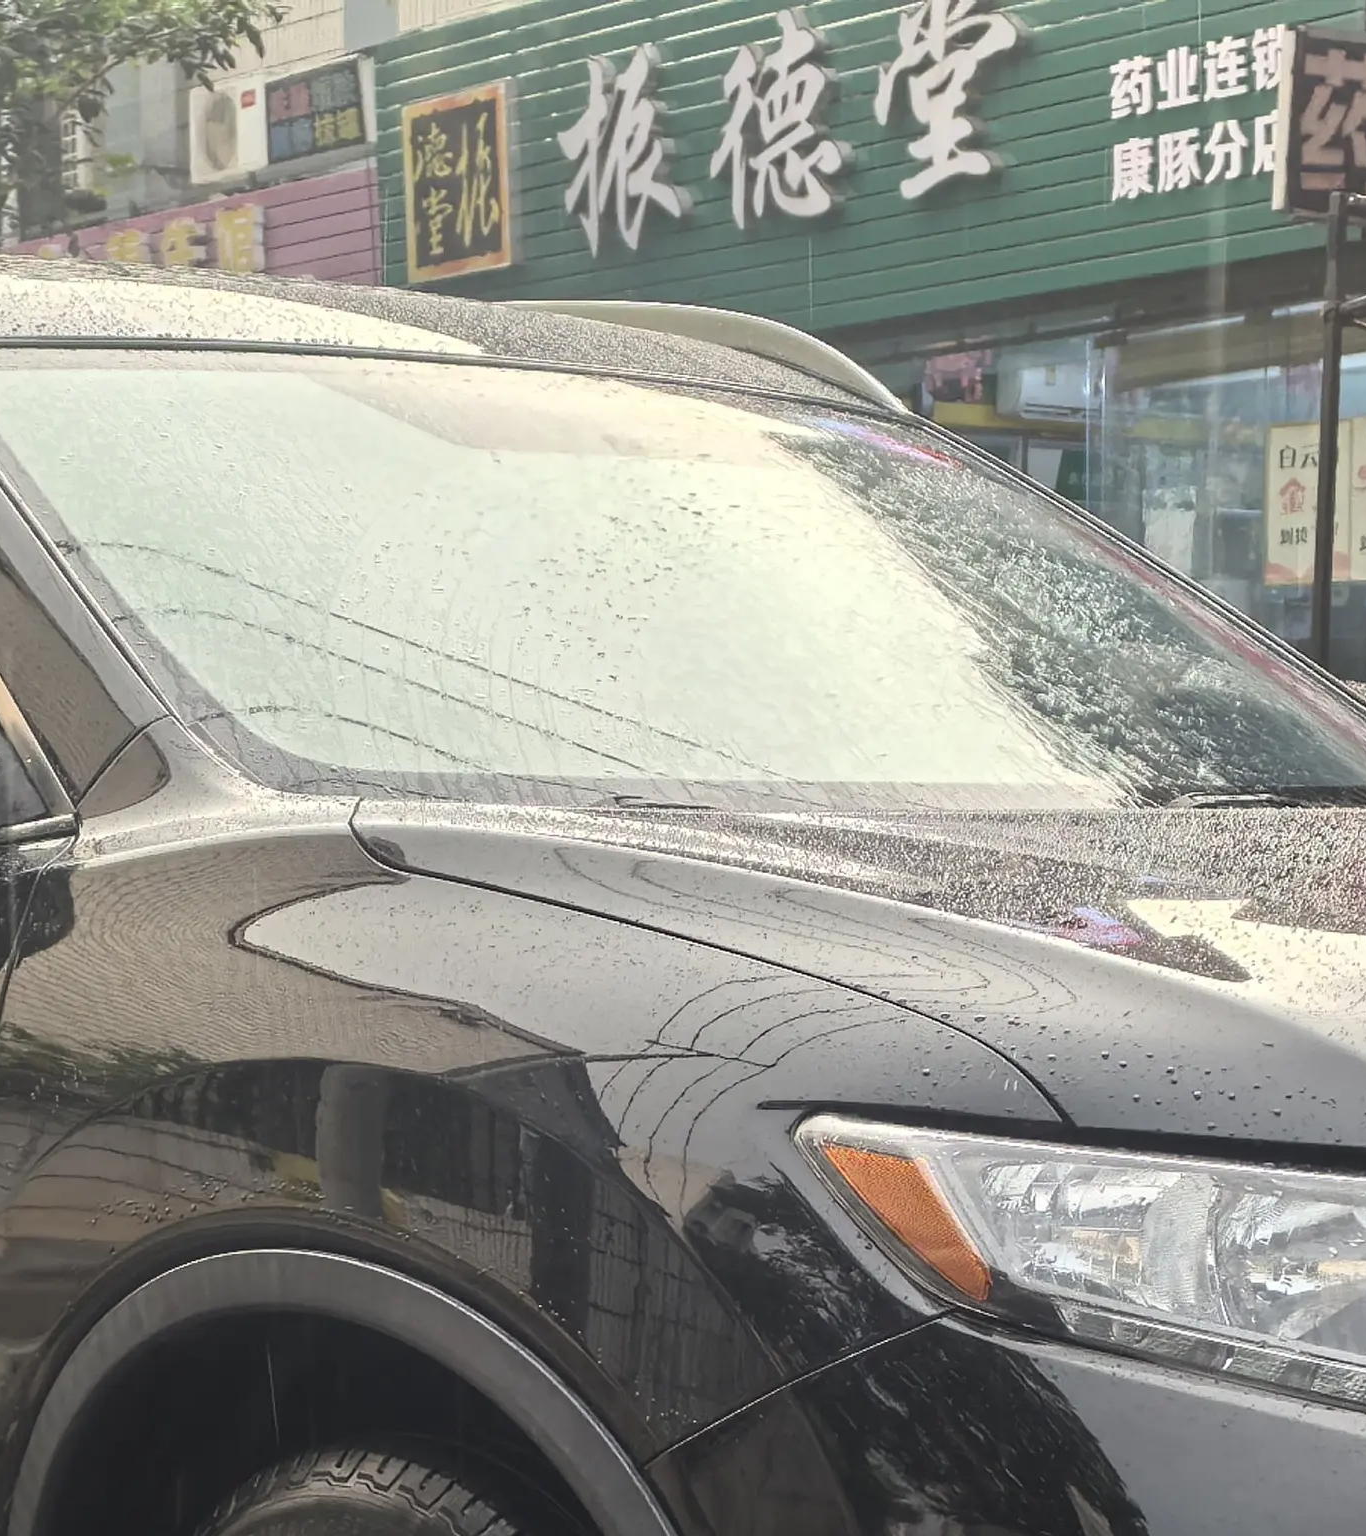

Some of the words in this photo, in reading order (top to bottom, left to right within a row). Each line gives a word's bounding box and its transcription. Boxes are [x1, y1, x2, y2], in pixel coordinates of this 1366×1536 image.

[557, 0, 1021, 258] 振德堂
[1110, 25, 1285, 119] 药业连锁
